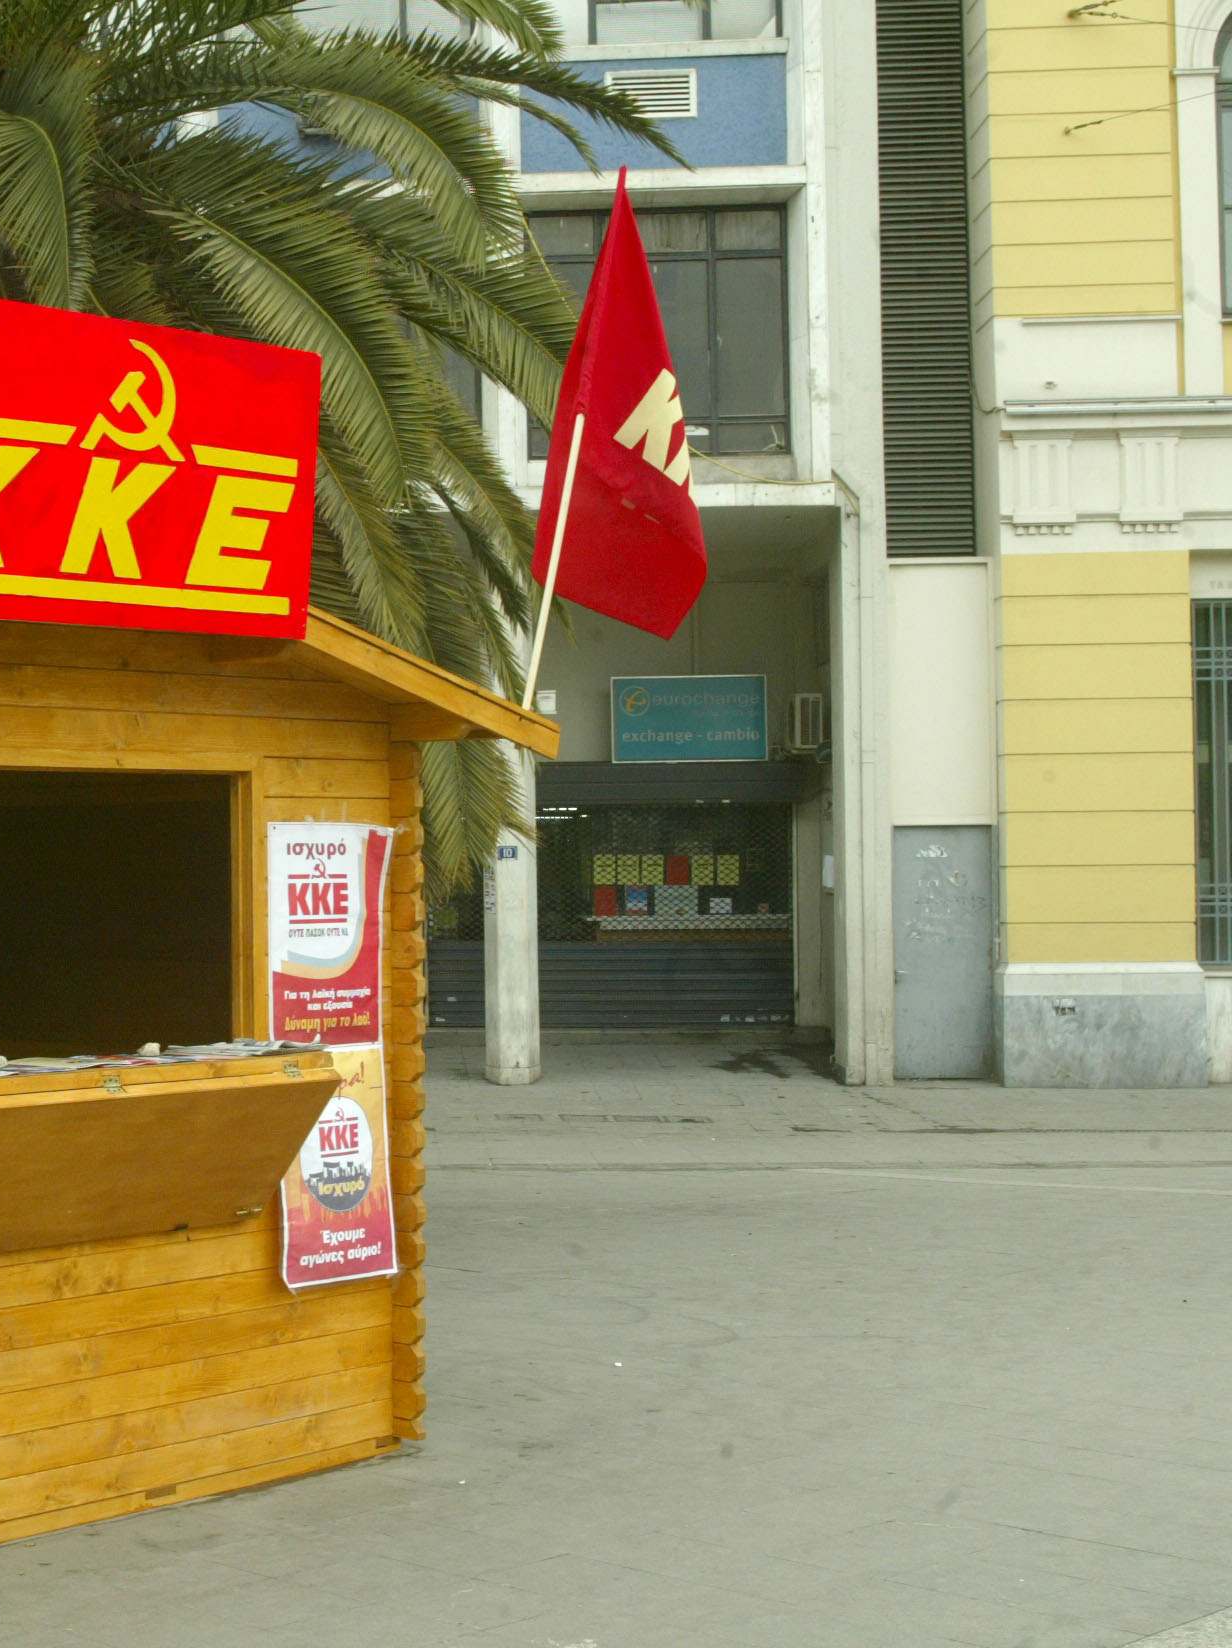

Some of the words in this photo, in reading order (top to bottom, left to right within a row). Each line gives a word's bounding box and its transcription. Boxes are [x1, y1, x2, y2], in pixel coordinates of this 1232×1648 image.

[652, 691, 761, 708] eurochange
[622, 728, 694, 744] exchange
[706, 727, 761, 741] cambio
[286, 838, 347, 860] ισχυρό
[503, 848, 513, 857] 10
[287, 882, 349, 916] ΚΚΕ
[284, 1015, 321, 1033] Δύναμη
[323, 1016, 338, 1032] για
[339, 1016, 351, 1027] το
[319, 1123, 359, 1152] ΚΚΕ
[320, 1228, 366, 1246] Έχουμε
[300, 1250, 345, 1268] αγώνες
[347, 1241, 382, 1261] αύριο!
